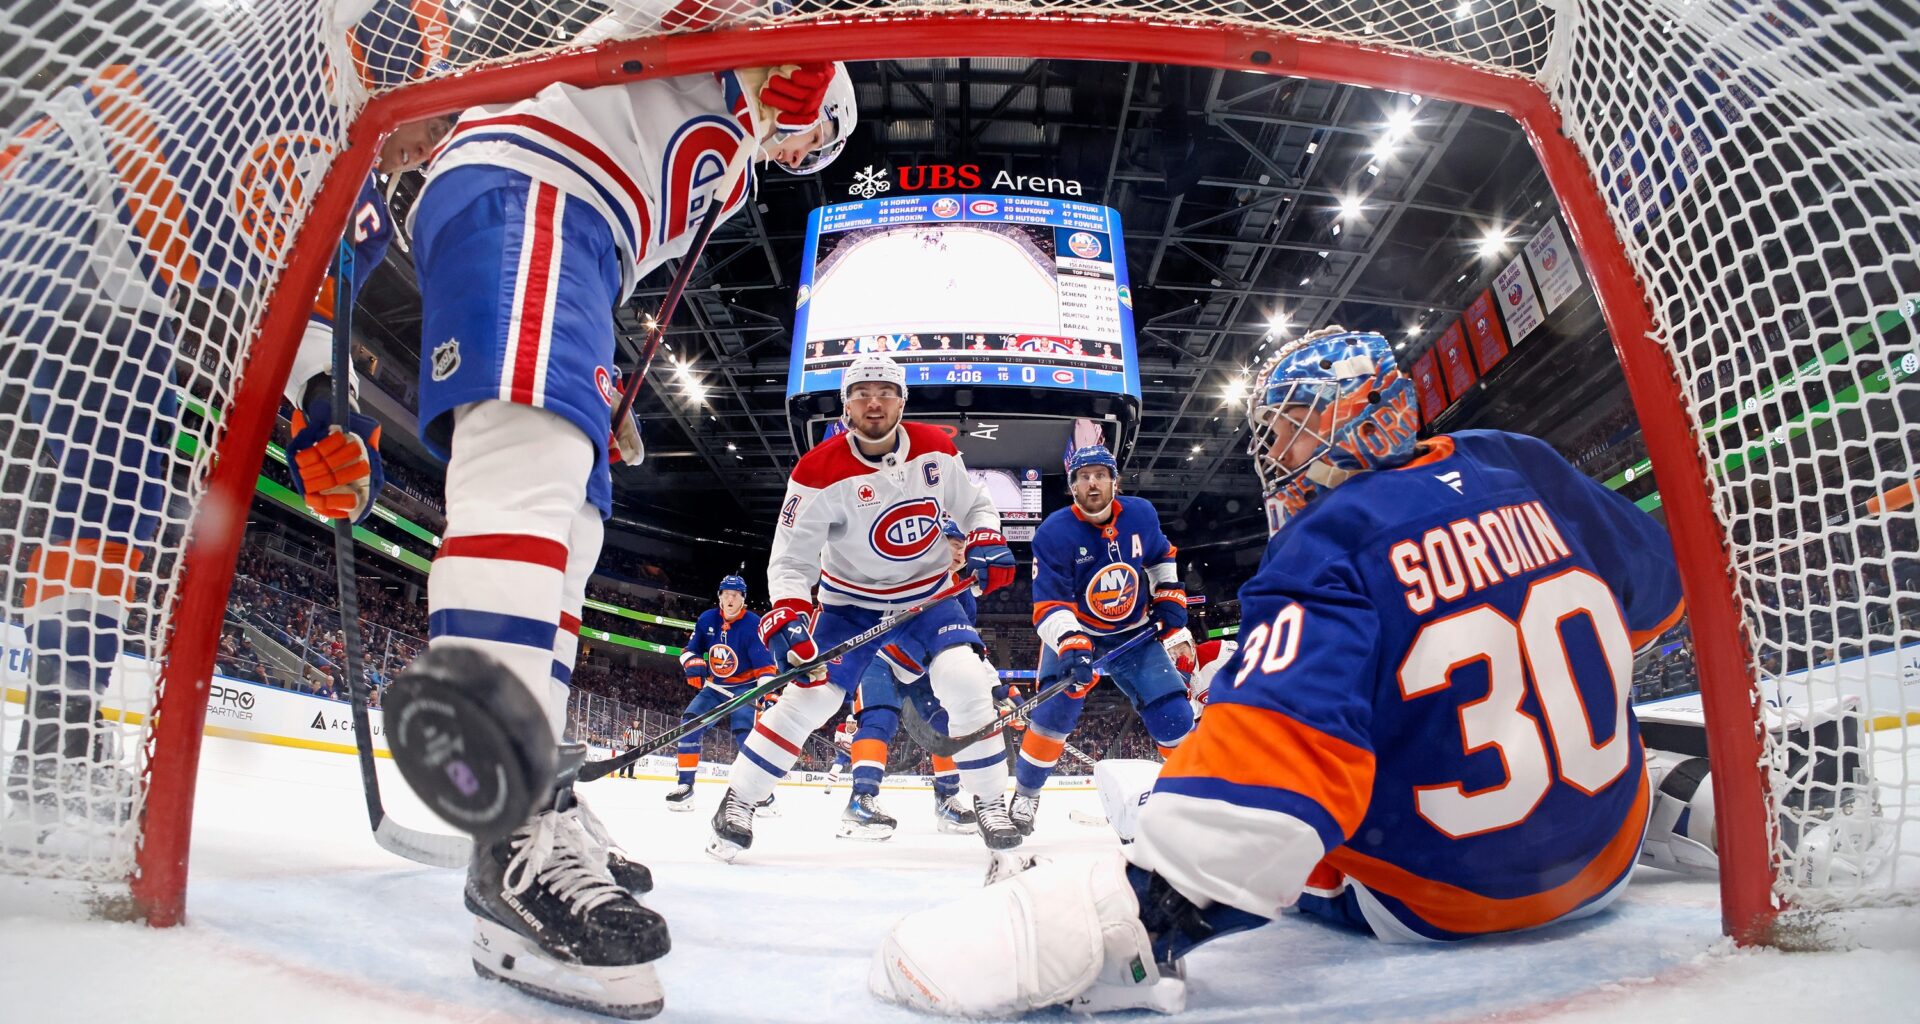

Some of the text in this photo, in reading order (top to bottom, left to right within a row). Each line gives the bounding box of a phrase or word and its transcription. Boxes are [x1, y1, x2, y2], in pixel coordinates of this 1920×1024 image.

[897, 164, 1083, 196] UBS Arena
[835, 203, 863, 212] PULOCK
[890, 198, 920, 206] HORVAT
[890, 206, 928, 214] SCHAEFER
[834, 213, 847, 221] LEE
[920, 372, 930, 381] 11
[946, 371, 982, 383] 4:06
[998, 372, 1009, 381] 15
[1021, 366, 1036, 383] 0
[1338, 390, 1421, 469] YORK
[921, 460, 940, 488] C
[1131, 533, 1143, 558] A
[1075, 555, 1095, 564] VANDA
[1388, 500, 1573, 615] SOROKIN
[855, 616, 897, 643] BAUER
[938, 623, 977, 635] BAUE
[1233, 601, 1306, 690] 30
[1396, 566, 1634, 840] 30
[206, 704, 253, 721] PARTNER
[639, 726, 685, 755] FLYLITE
[500, 890, 545, 932] BAUER
